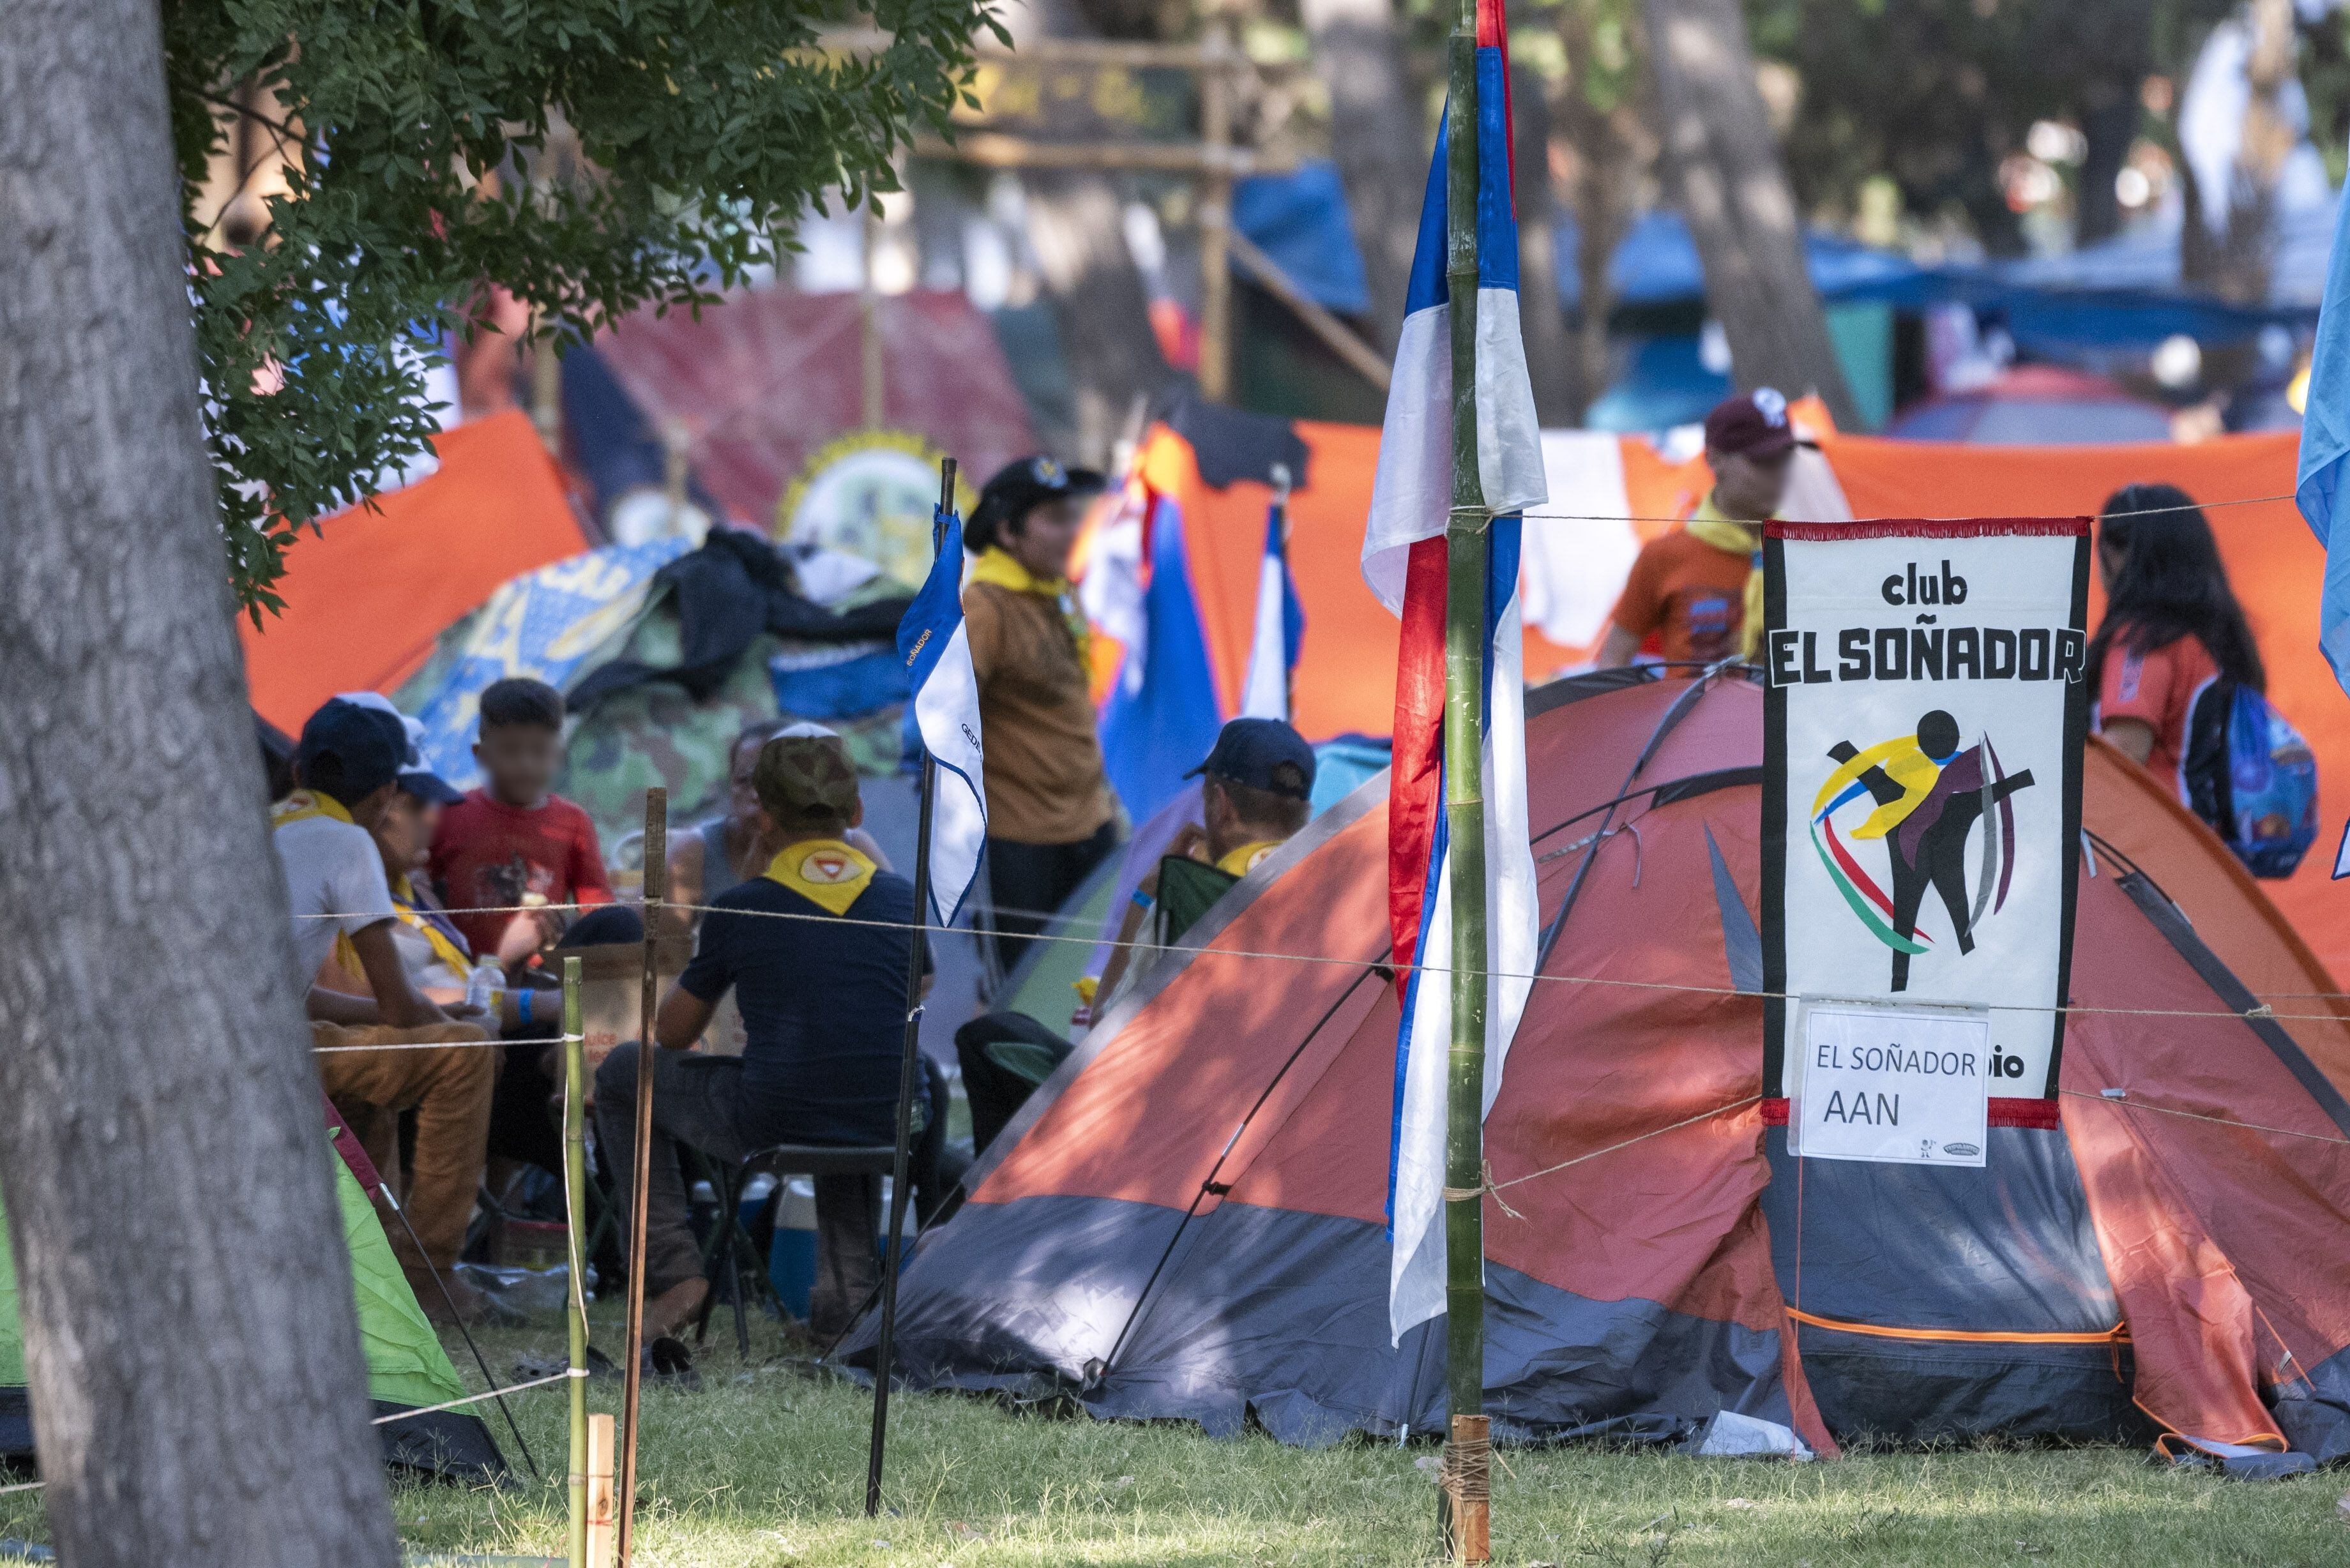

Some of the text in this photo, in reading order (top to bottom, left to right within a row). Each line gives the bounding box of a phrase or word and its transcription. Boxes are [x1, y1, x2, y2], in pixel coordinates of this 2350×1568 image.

[1881, 559, 1967, 605] club
[1770, 613, 2086, 687] EL SOÑADOR
[961, 723, 984, 763] GEDE
[1817, 1043, 1976, 1077] EL SOÑADOR
[1988, 1044, 2025, 1079] io
[1823, 1090, 1900, 1127] AAN
